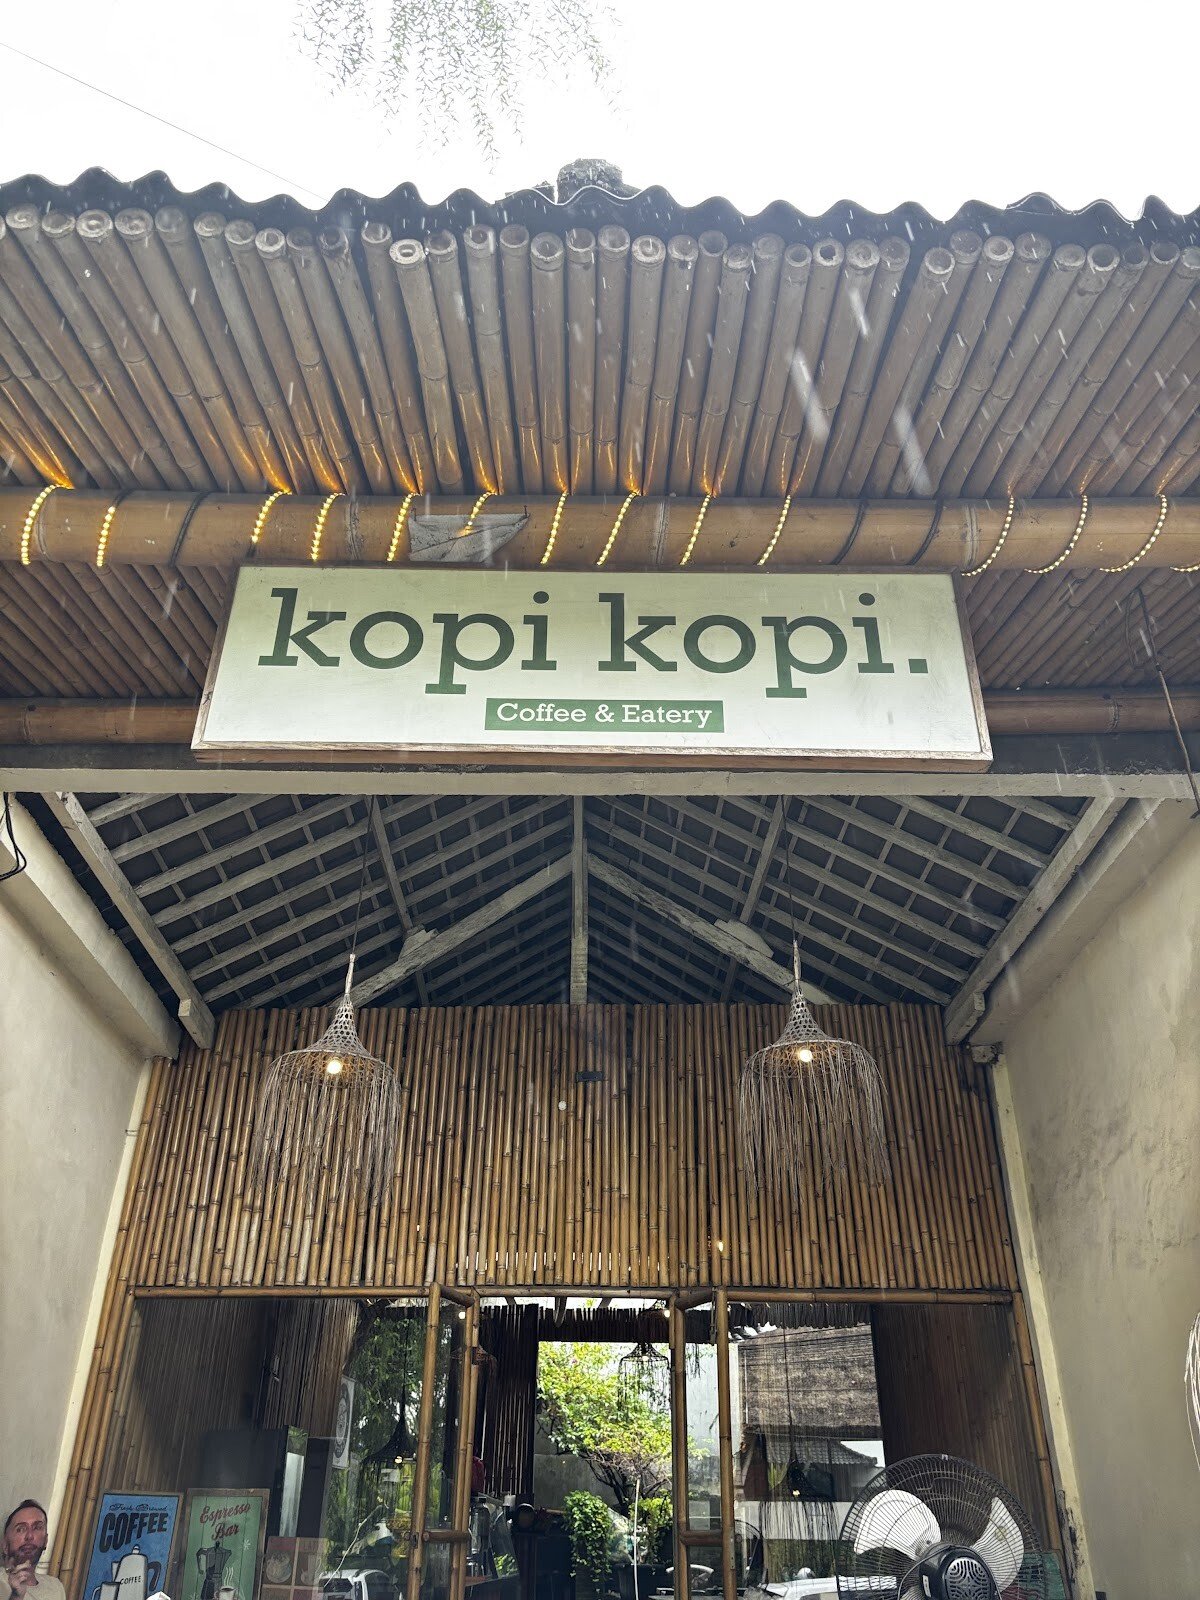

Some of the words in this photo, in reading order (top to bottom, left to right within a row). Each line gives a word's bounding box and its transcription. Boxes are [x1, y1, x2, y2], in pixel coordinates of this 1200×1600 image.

[257, 587, 558, 695] kopi
[598, 592, 929, 698] kopi.
[496, 702, 588, 726] Coffee
[594, 703, 616, 724] &
[618, 704, 713, 731] Eatery
[200, 1503, 251, 1524] Espresso
[99, 1512, 169, 1553] COFFEE
[211, 1523, 240, 1541] Bar
[120, 1575, 142, 1586] COFFEE
